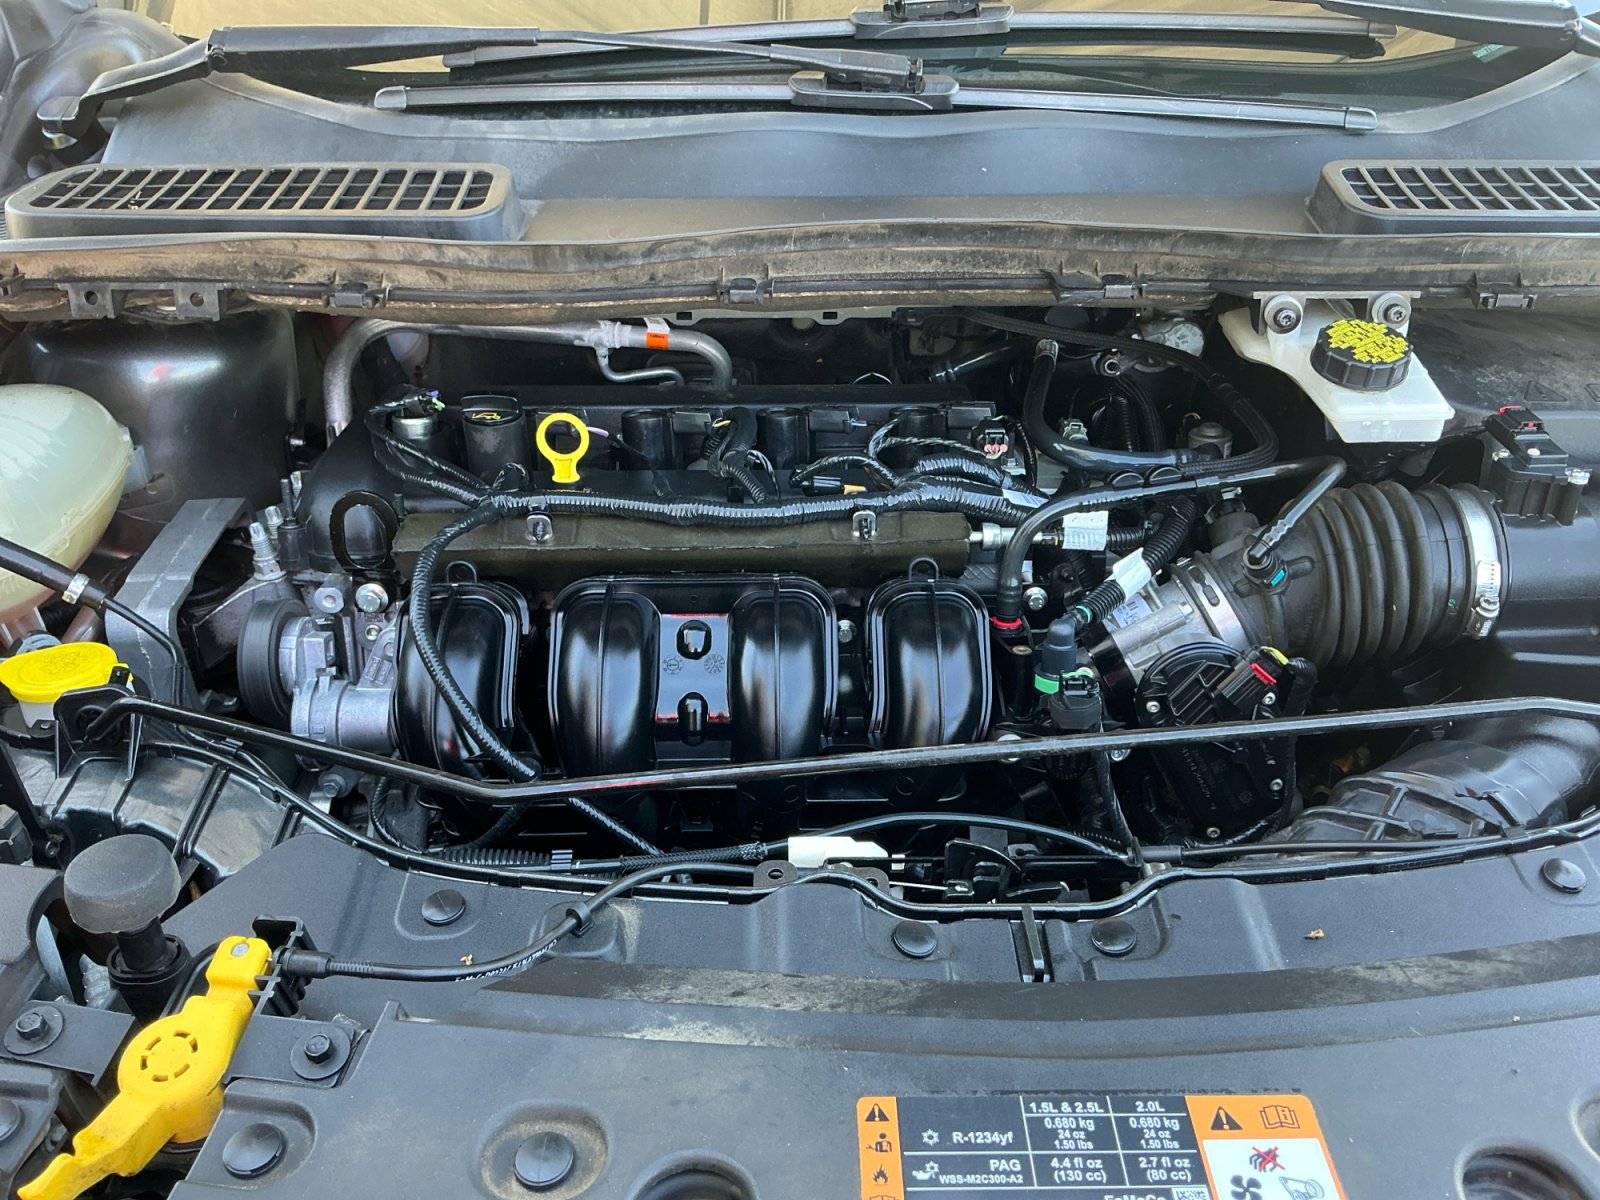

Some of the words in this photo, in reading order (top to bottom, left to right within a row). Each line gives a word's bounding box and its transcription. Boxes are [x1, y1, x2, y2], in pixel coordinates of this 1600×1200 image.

[1029, 1102, 1058, 1113] 1.5L
[1061, 1102, 1072, 1113] &
[1074, 1102, 1104, 1113] 2.5L
[1135, 1101, 1165, 1112] 2.0L
[1044, 1117, 1076, 1129] 0.680
[1079, 1117, 1095, 1131] kg
[1129, 1117, 1161, 1128] 0.680
[1163, 1117, 1180, 1131] kg
[951, 1131, 1014, 1146] R-1234yf
[1058, 1130, 1070, 1139] 24
[1073, 1131, 1086, 1139] oz
[1143, 1129, 1156, 1138] 24
[1054, 1140, 1075, 1149] 1.50
[1077, 1139, 1093, 1149] lbs
[1140, 1139, 1161, 1149] 1.50
[1163, 1139, 1179, 1149] lbs
[989, 1159, 1022, 1172] PAG
[1050, 1157, 1071, 1169] 4.4
[1073, 1157, 1084, 1168] fl
[1086, 1159, 1103, 1168] oz
[1138, 1157, 1158, 1168] 2.7
[1161, 1157, 1171, 1168] fl
[1174, 1158, 1190, 1168] oz
[938, 1174, 1024, 1184] WSS-M2C300-A2
[1054, 1170, 1082, 1184] (130
[1085, 1170, 1107, 1184] cc)
[1146, 1169, 1167, 1183] (80
[1170, 1169, 1192, 1183] cc)
